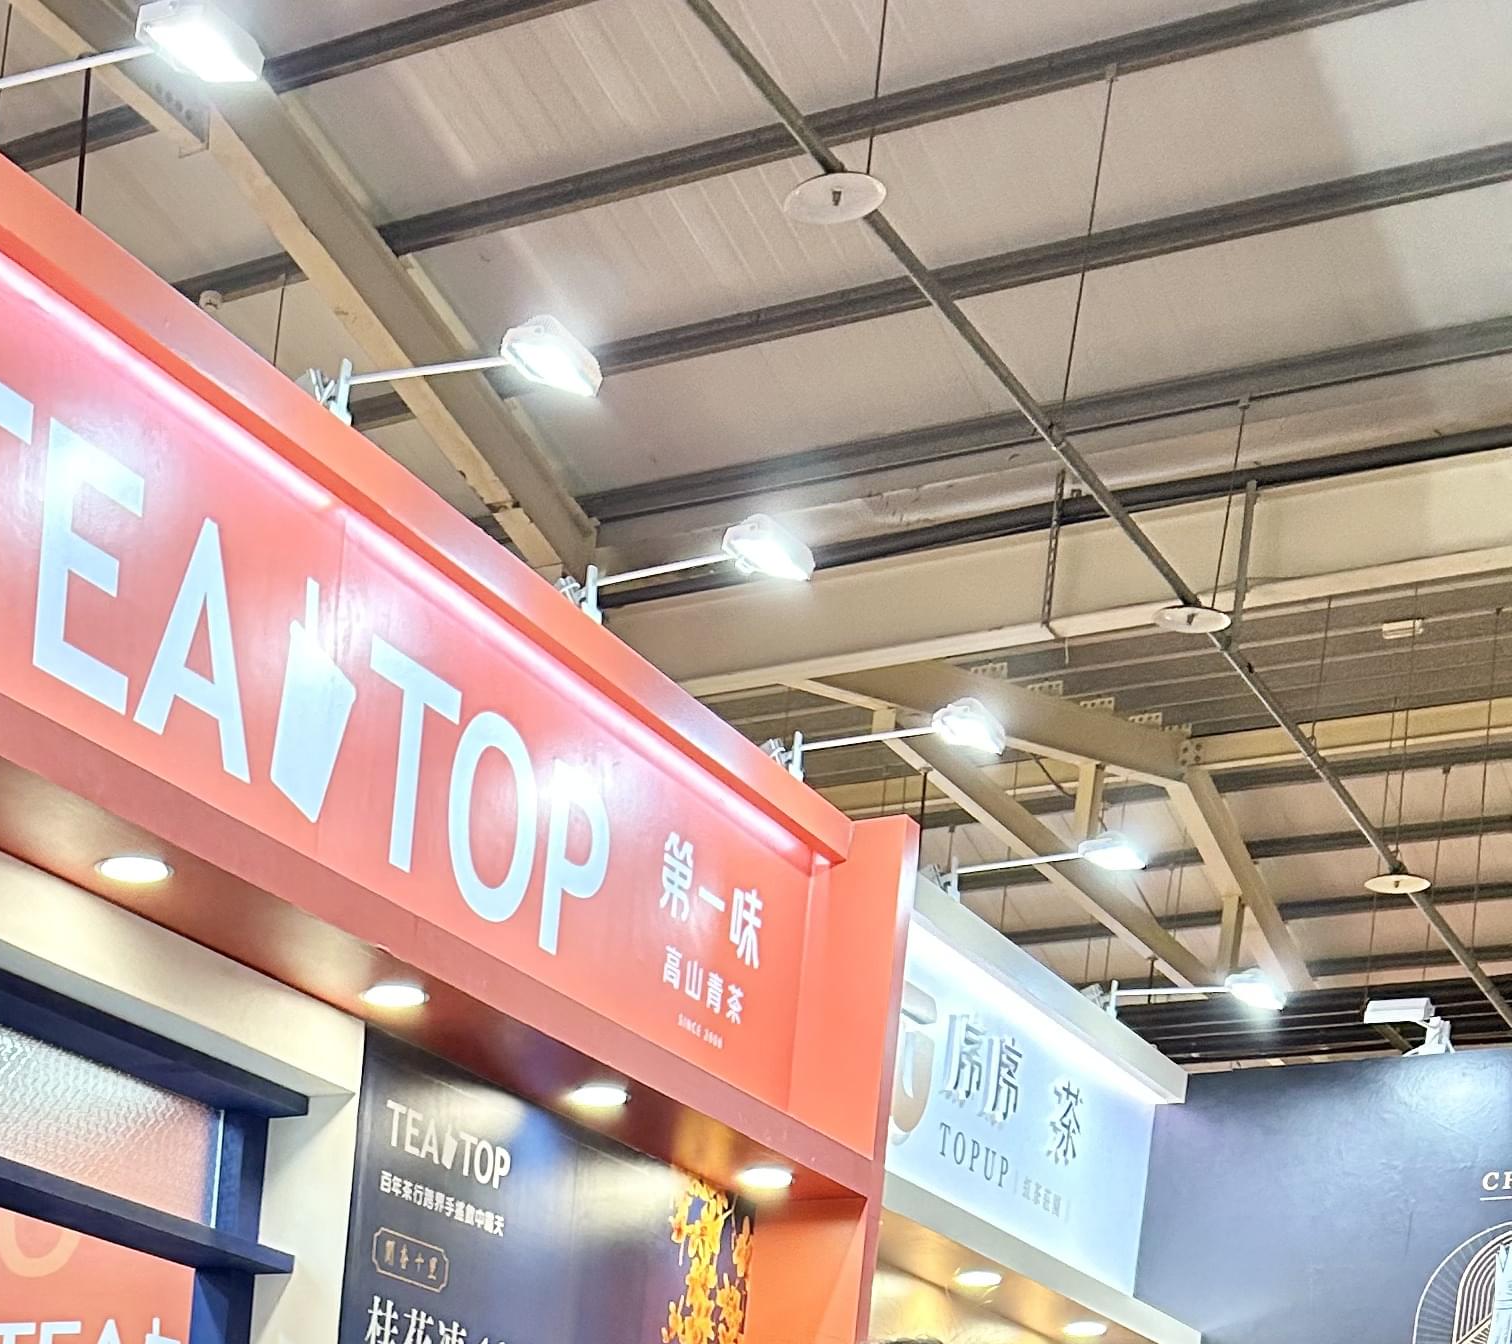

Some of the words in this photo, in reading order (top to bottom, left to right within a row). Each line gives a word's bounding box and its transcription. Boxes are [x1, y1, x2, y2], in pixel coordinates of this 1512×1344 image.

[367, 634, 611, 955] TOP
[662, 831, 763, 971] 第一味
[662, 946, 745, 1027] 高山青茶
[386, 1099, 440, 1164] TEA
[459, 1131, 511, 1189] TOP
[940, 1122, 1009, 1188] TOPUP
